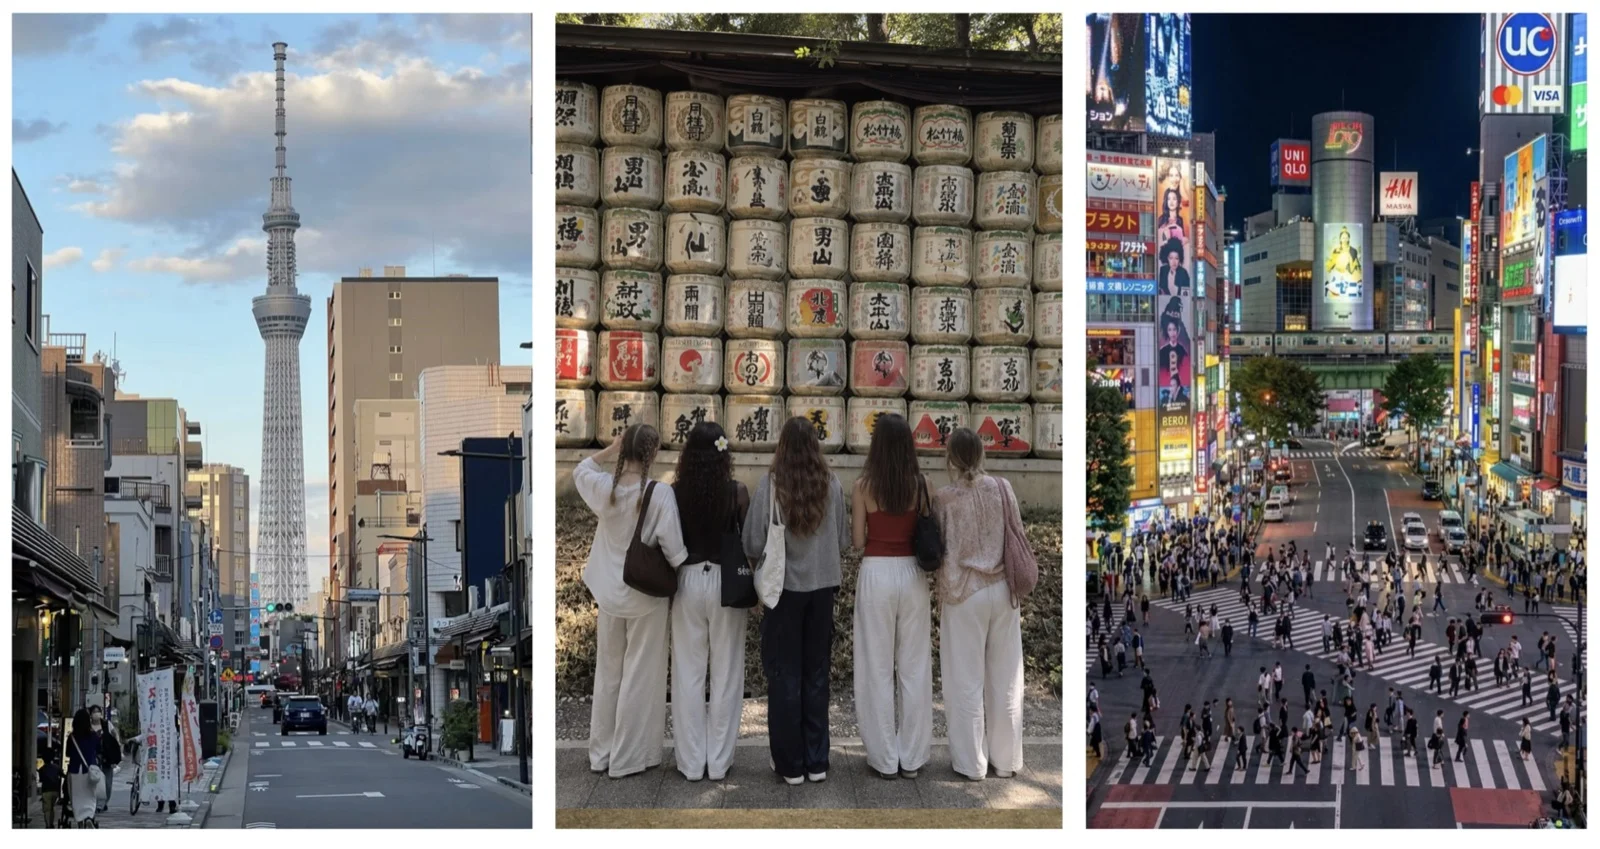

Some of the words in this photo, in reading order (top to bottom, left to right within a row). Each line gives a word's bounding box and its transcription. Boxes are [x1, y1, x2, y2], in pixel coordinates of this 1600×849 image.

[1534, 90, 1559, 101] VISA
[1285, 150, 1305, 161] UNI
[1284, 163, 1307, 176] QLO
[1385, 178, 1413, 199] H&M
